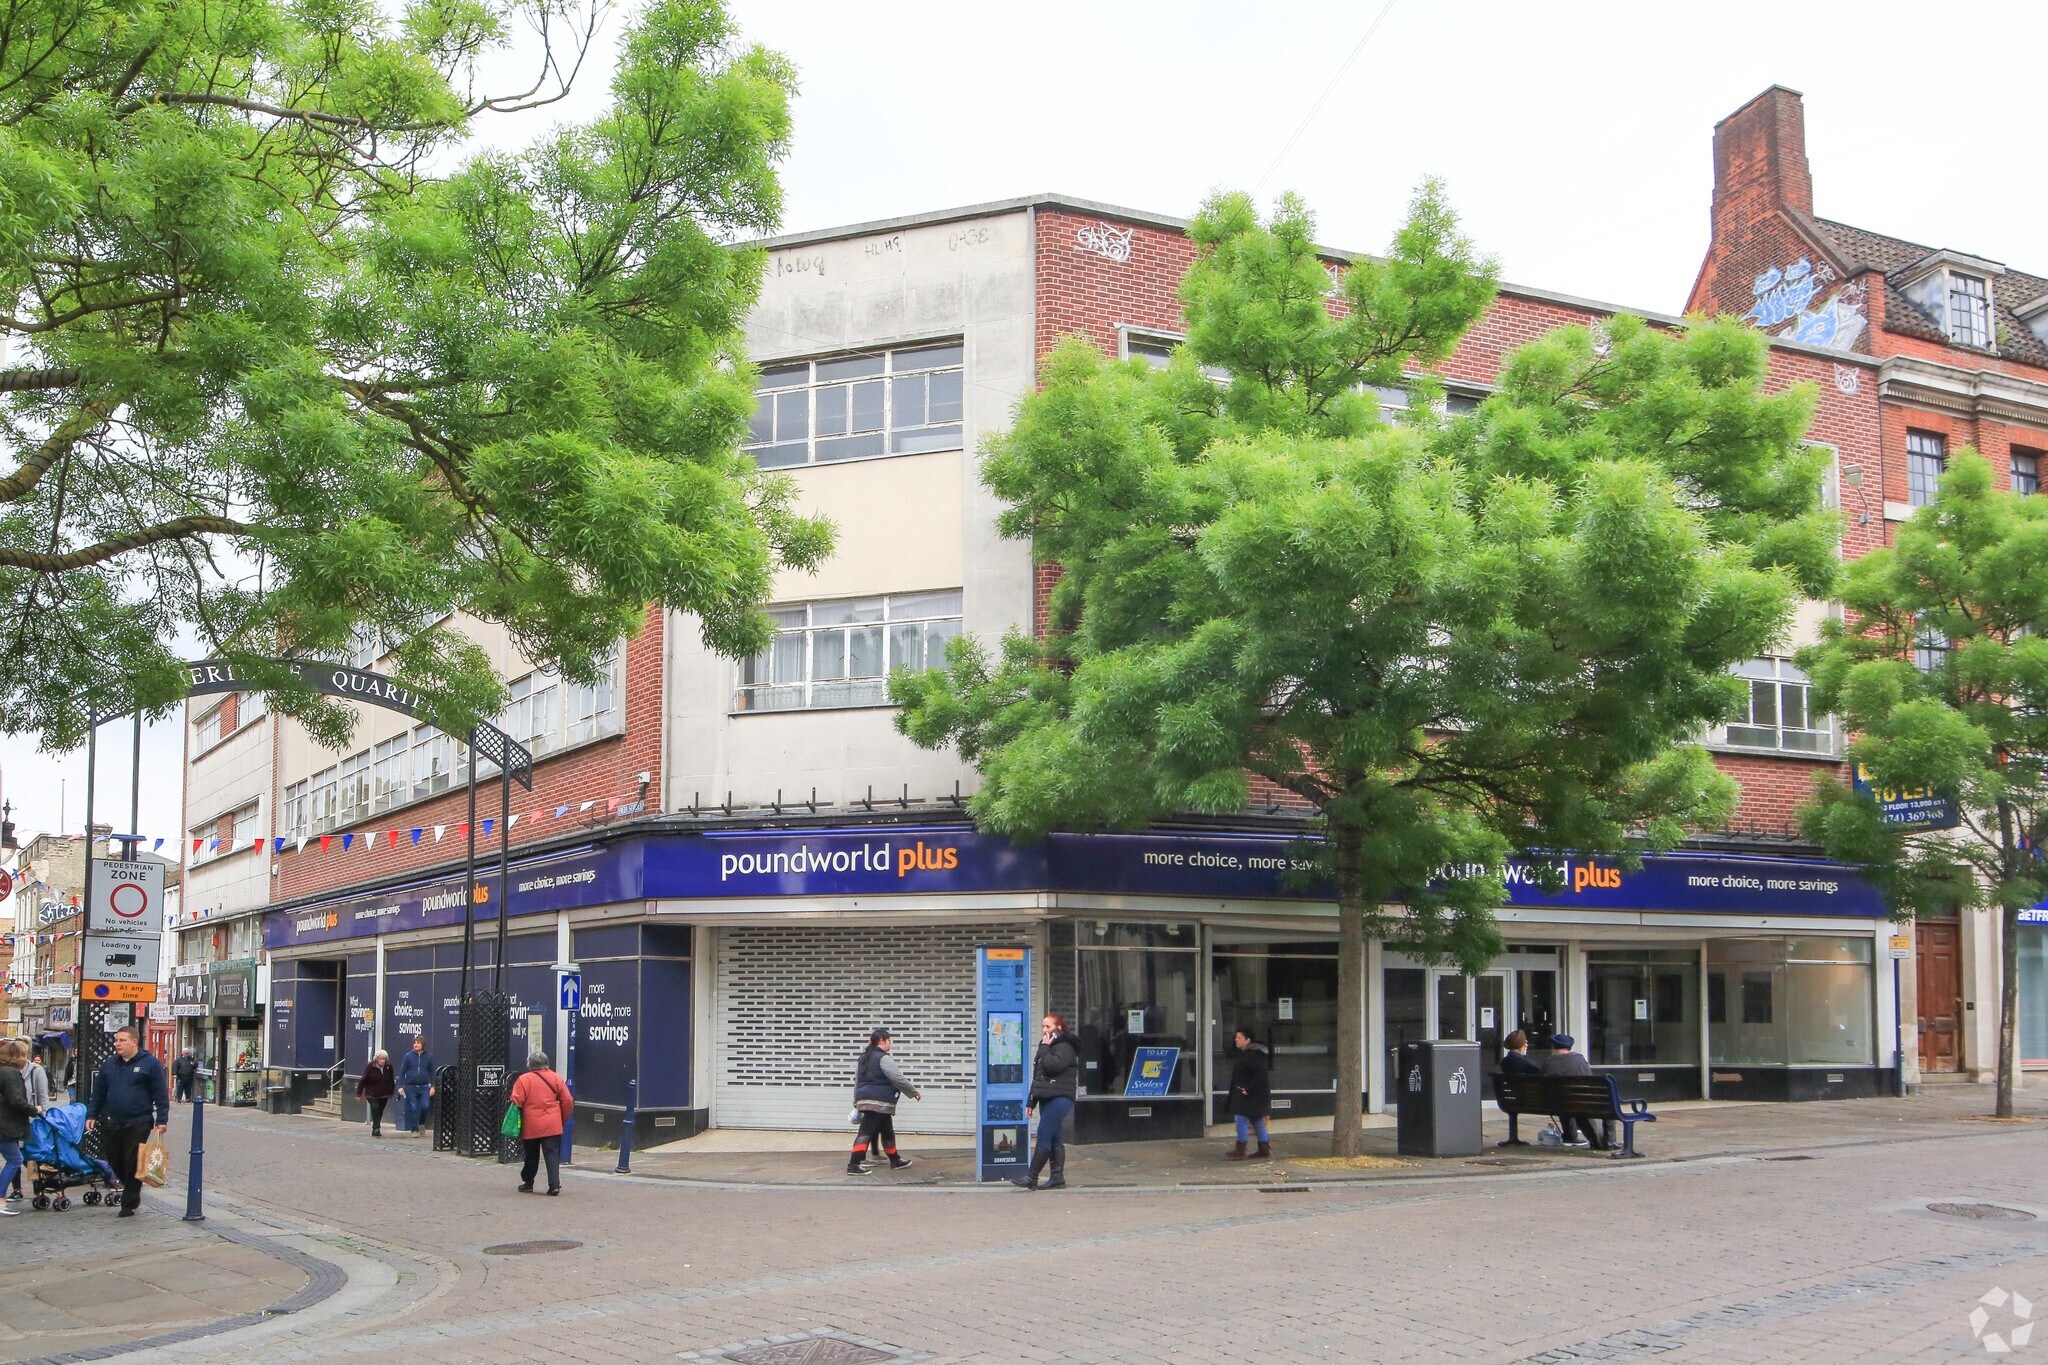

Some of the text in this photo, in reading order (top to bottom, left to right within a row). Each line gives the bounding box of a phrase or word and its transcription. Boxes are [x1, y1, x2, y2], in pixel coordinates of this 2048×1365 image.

[103, 861, 154, 871] PEDESTRIAN
[721, 841, 958, 882] poundworld plus
[1144, 852, 1184, 865] more
[1188, 852, 1242, 871] choice,
[1248, 857, 1286, 870] more
[111, 870, 146, 881] ZONE
[518, 869, 596, 892] more choice, more savings
[1574, 861, 1622, 893] plus
[1688, 875, 1839, 894] more choice, more savings
[473, 882, 489, 904] lus
[101, 941, 142, 951] Loading by
[398, 990, 409, 999] more
[589, 984, 605, 994] more
[394, 1001, 414, 1018] choice,
[581, 997, 631, 1020] choice, more
[398, 1019, 422, 1038] savings
[589, 1020, 629, 1047] savings
[484, 1071, 498, 1080] High
